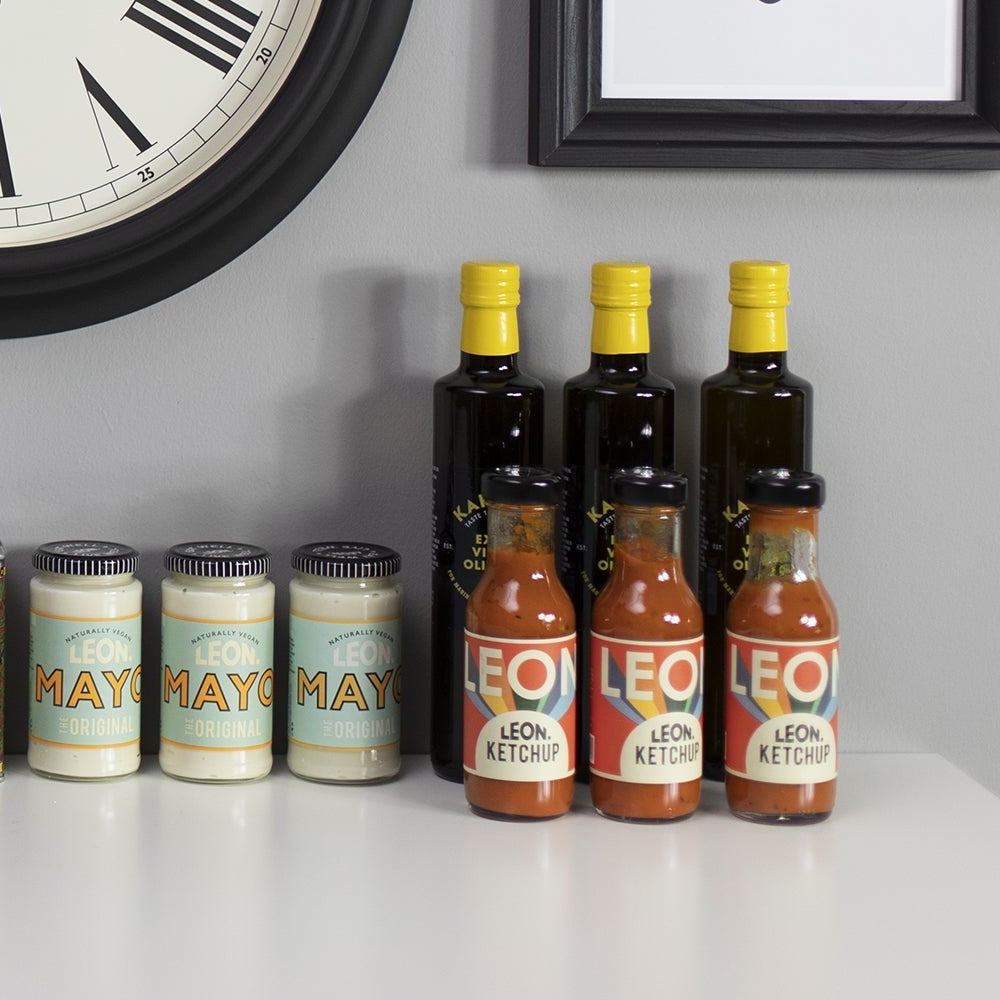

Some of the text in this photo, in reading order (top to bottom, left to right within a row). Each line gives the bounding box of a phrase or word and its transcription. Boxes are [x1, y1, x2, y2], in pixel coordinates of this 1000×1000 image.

[256, 47, 272, 65] 20
[75, 57, 158, 172] V
[137, 167, 155, 183] 25
[464, 513, 482, 528] TASTE
[65, 628, 132, 644] NATURALLY VEGAN
[191, 630, 260, 645] NATURALLY VEGAN
[328, 630, 394, 646] NATURALLY VEGAN
[70, 637, 132, 665] LEON.
[195, 640, 260, 666] LEON.
[601, 646, 704, 701] LEO
[59, 716, 133, 736] THE ORIGINAL
[184, 718, 262, 738] THE ORIGINAL
[323, 716, 396, 738] THE ORIGINAL
[500, 722, 551, 740] LEON.
[651, 723, 694, 743] LEON.
[775, 724, 823, 743] LEON.
[487, 741, 559, 763] KETCHUP
[635, 742, 699, 765] KETCHUP
[760, 744, 830, 765] KETCHUP
